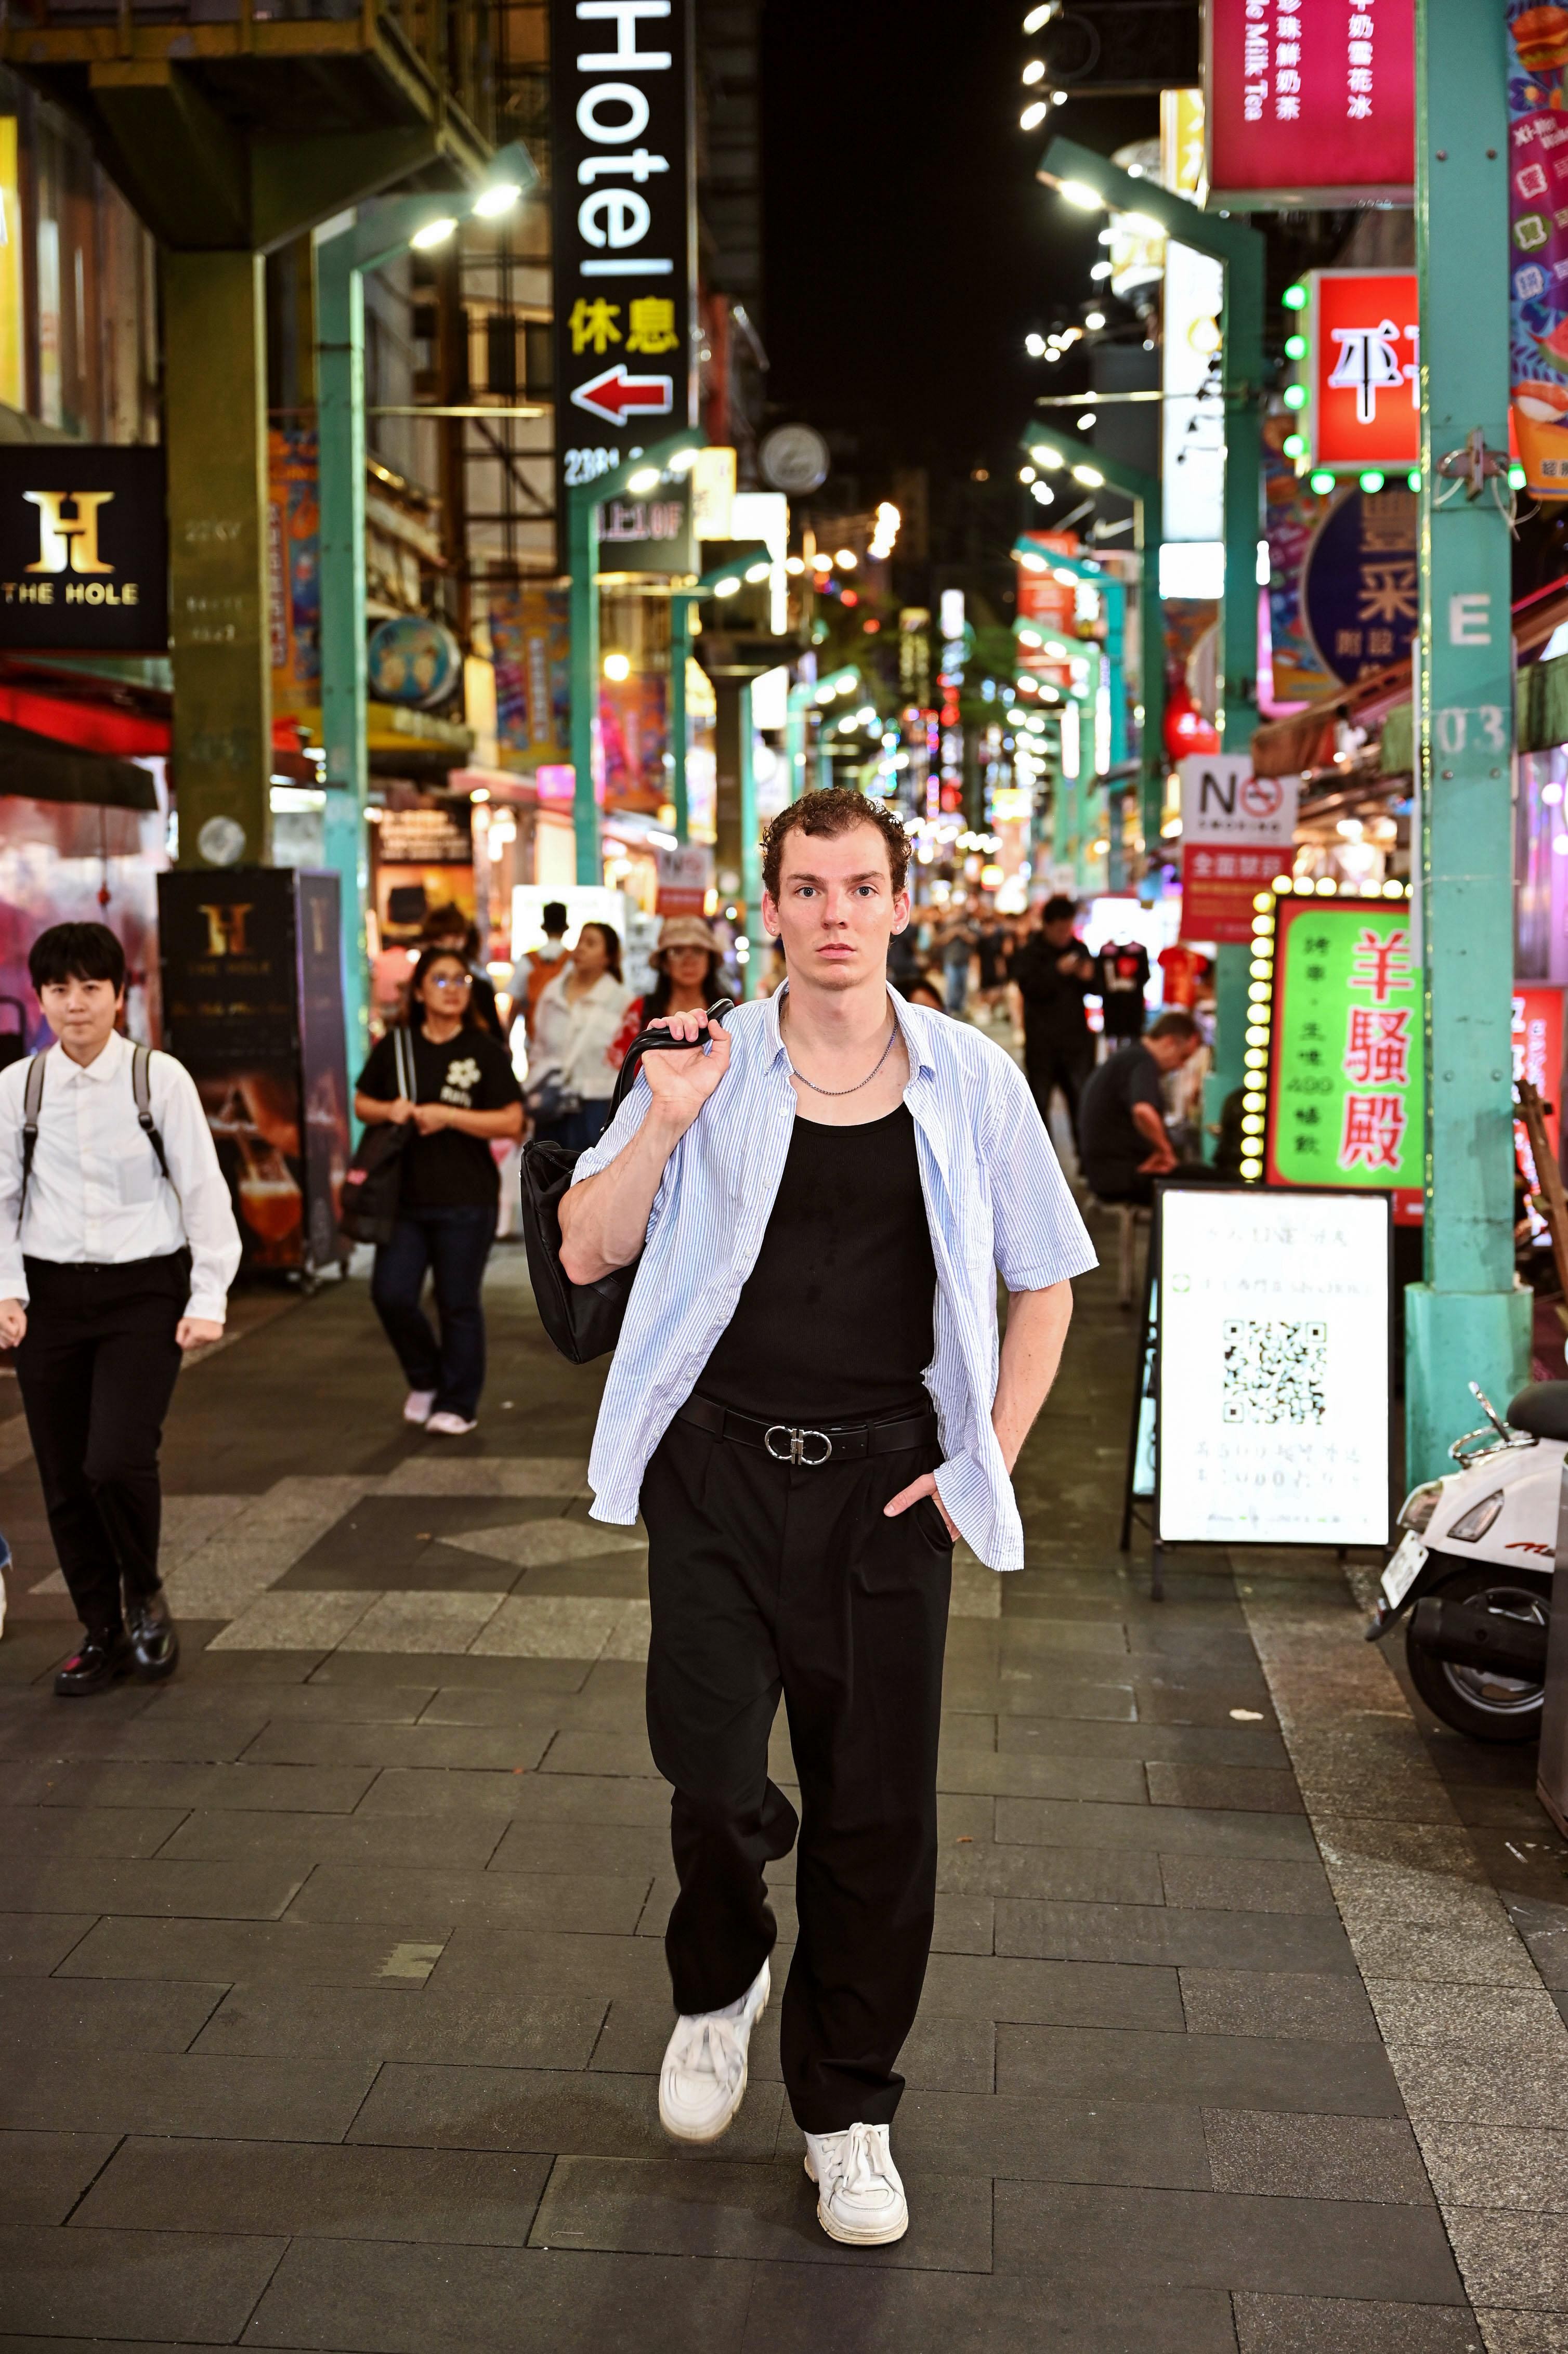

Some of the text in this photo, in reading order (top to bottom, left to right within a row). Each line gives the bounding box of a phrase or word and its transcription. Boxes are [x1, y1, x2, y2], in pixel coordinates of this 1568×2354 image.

[1245, 22, 1269, 77] Milk
[1244, 79, 1269, 122] Tea
[576, 0, 673, 277] Hotel
[568, 295, 680, 355] 休息
[1, 582, 139, 606] THE HOLE
[1451, 594, 1491, 645] E
[1436, 704, 1506, 753] 03
[1340, 928, 1413, 1171] 羊騷殿
